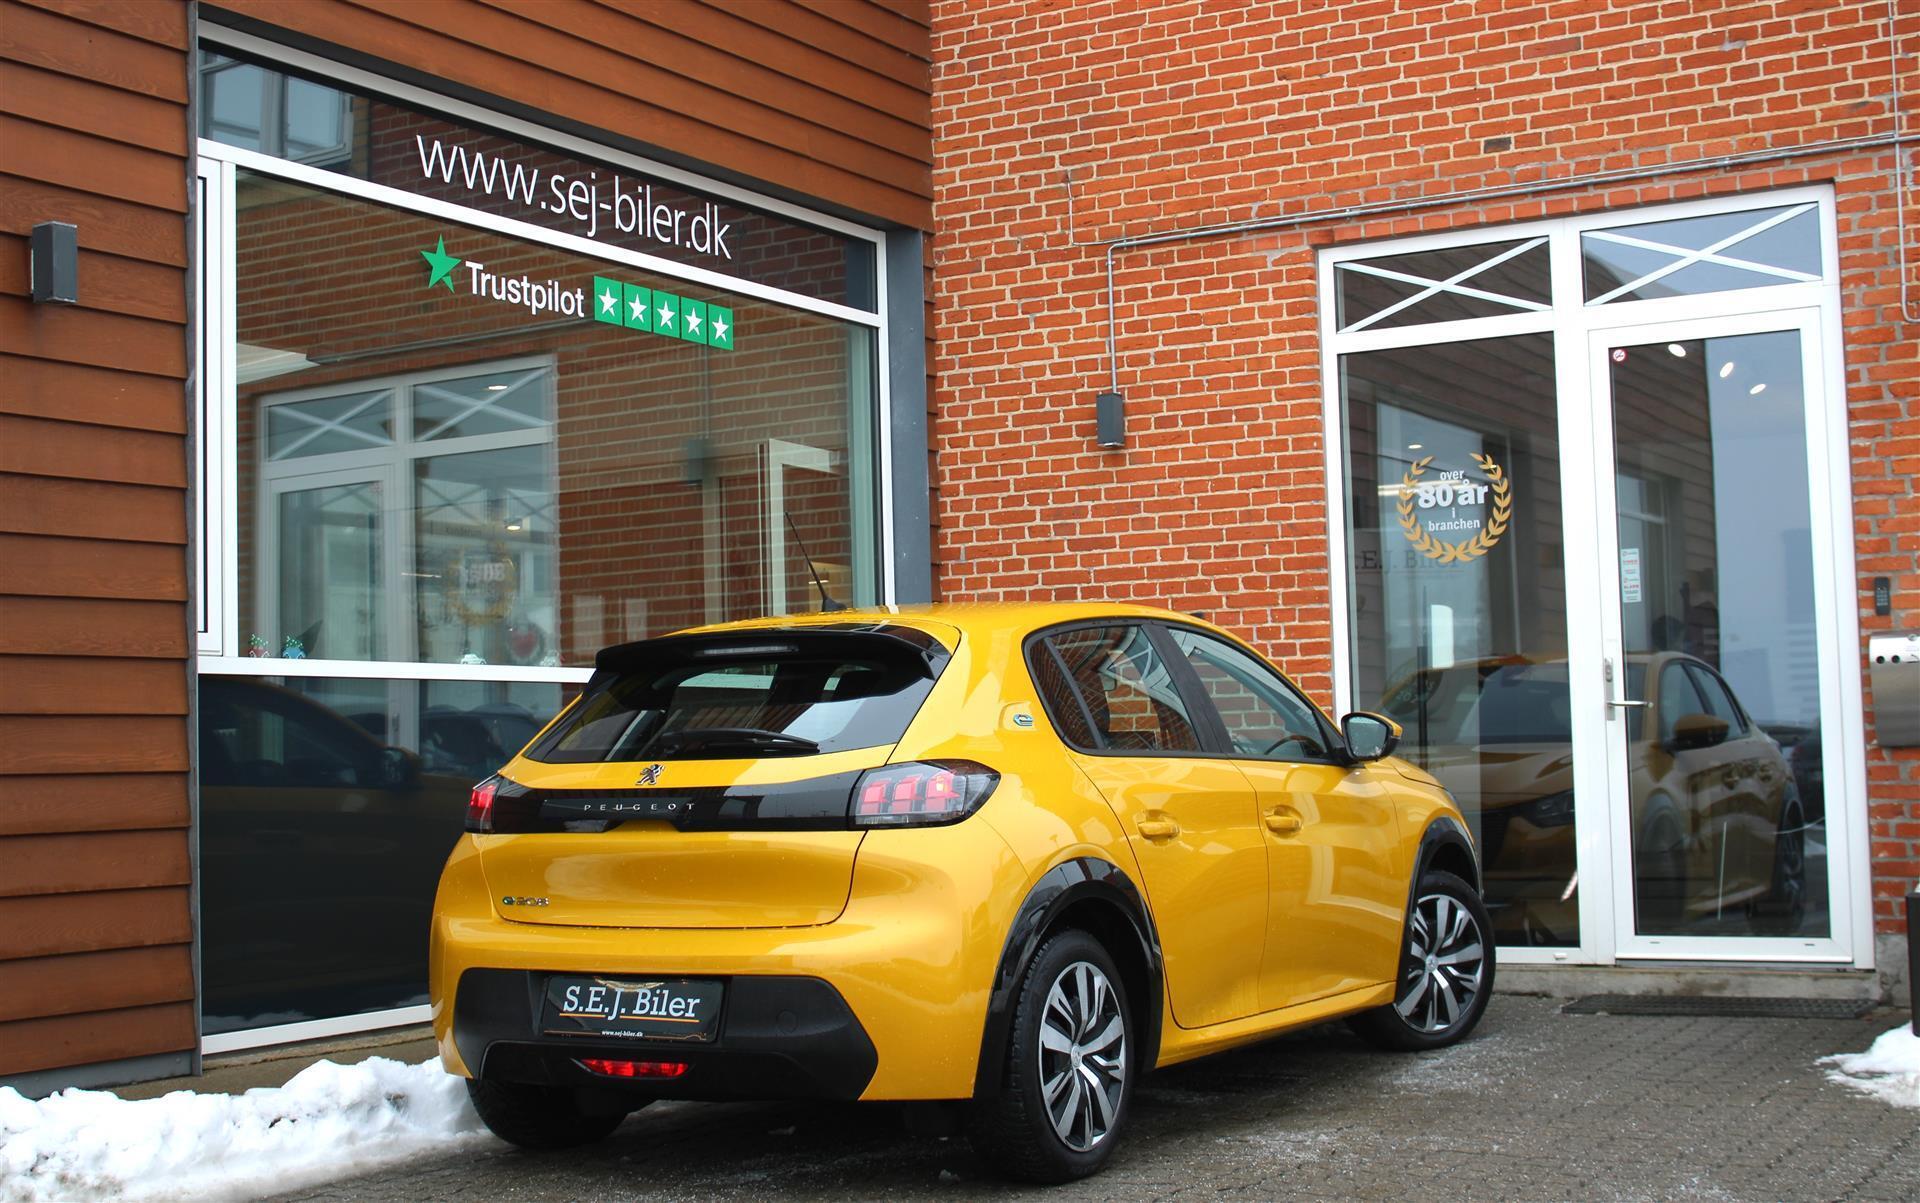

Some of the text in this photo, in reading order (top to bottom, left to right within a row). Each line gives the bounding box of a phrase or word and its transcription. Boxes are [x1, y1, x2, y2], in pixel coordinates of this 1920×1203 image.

[416, 135, 732, 260] www.sej-biler.dk
[465, 260, 585, 318] Trustpilot
[1440, 470, 1464, 481] over
[1418, 478, 1488, 508] 80 år
[1428, 518, 1480, 532] branchen
[584, 803, 695, 812] PEUGEOT
[563, 985, 700, 1020] S.E.J. Biler
[601, 1029, 644, 1038] www.sej-biler.dk
